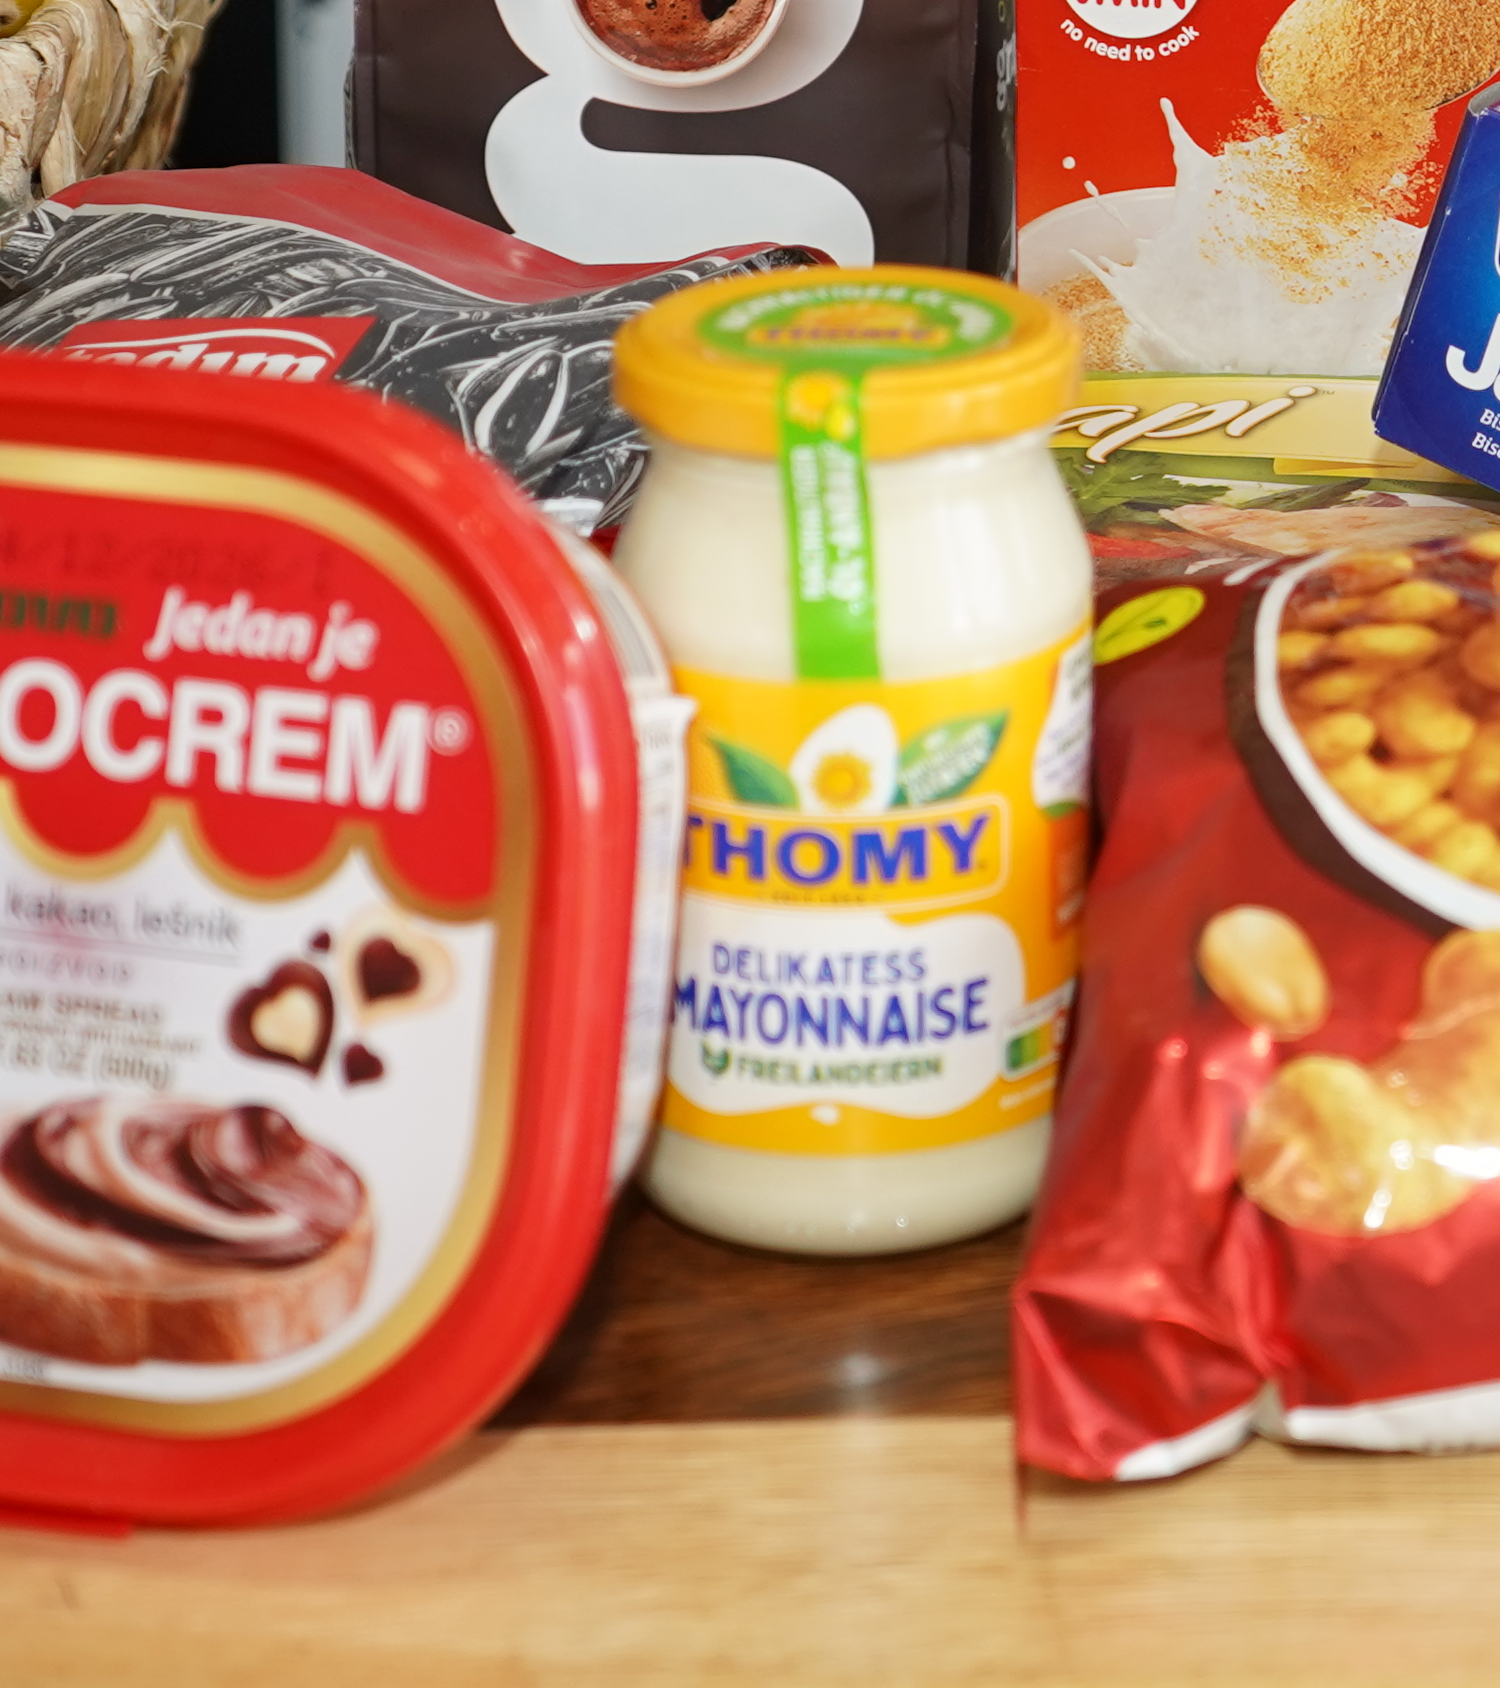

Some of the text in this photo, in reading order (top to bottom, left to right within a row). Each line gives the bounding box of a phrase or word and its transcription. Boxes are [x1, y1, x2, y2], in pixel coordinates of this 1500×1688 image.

[1060, 19, 1199, 61] no need to cook
[1052, 385, 1318, 463] api
[141, 585, 313, 663] Jedan
[306, 600, 379, 683] je
[711, 942, 927, 987] DELIKATESS
[671, 976, 991, 1051] MAYONNAISE
